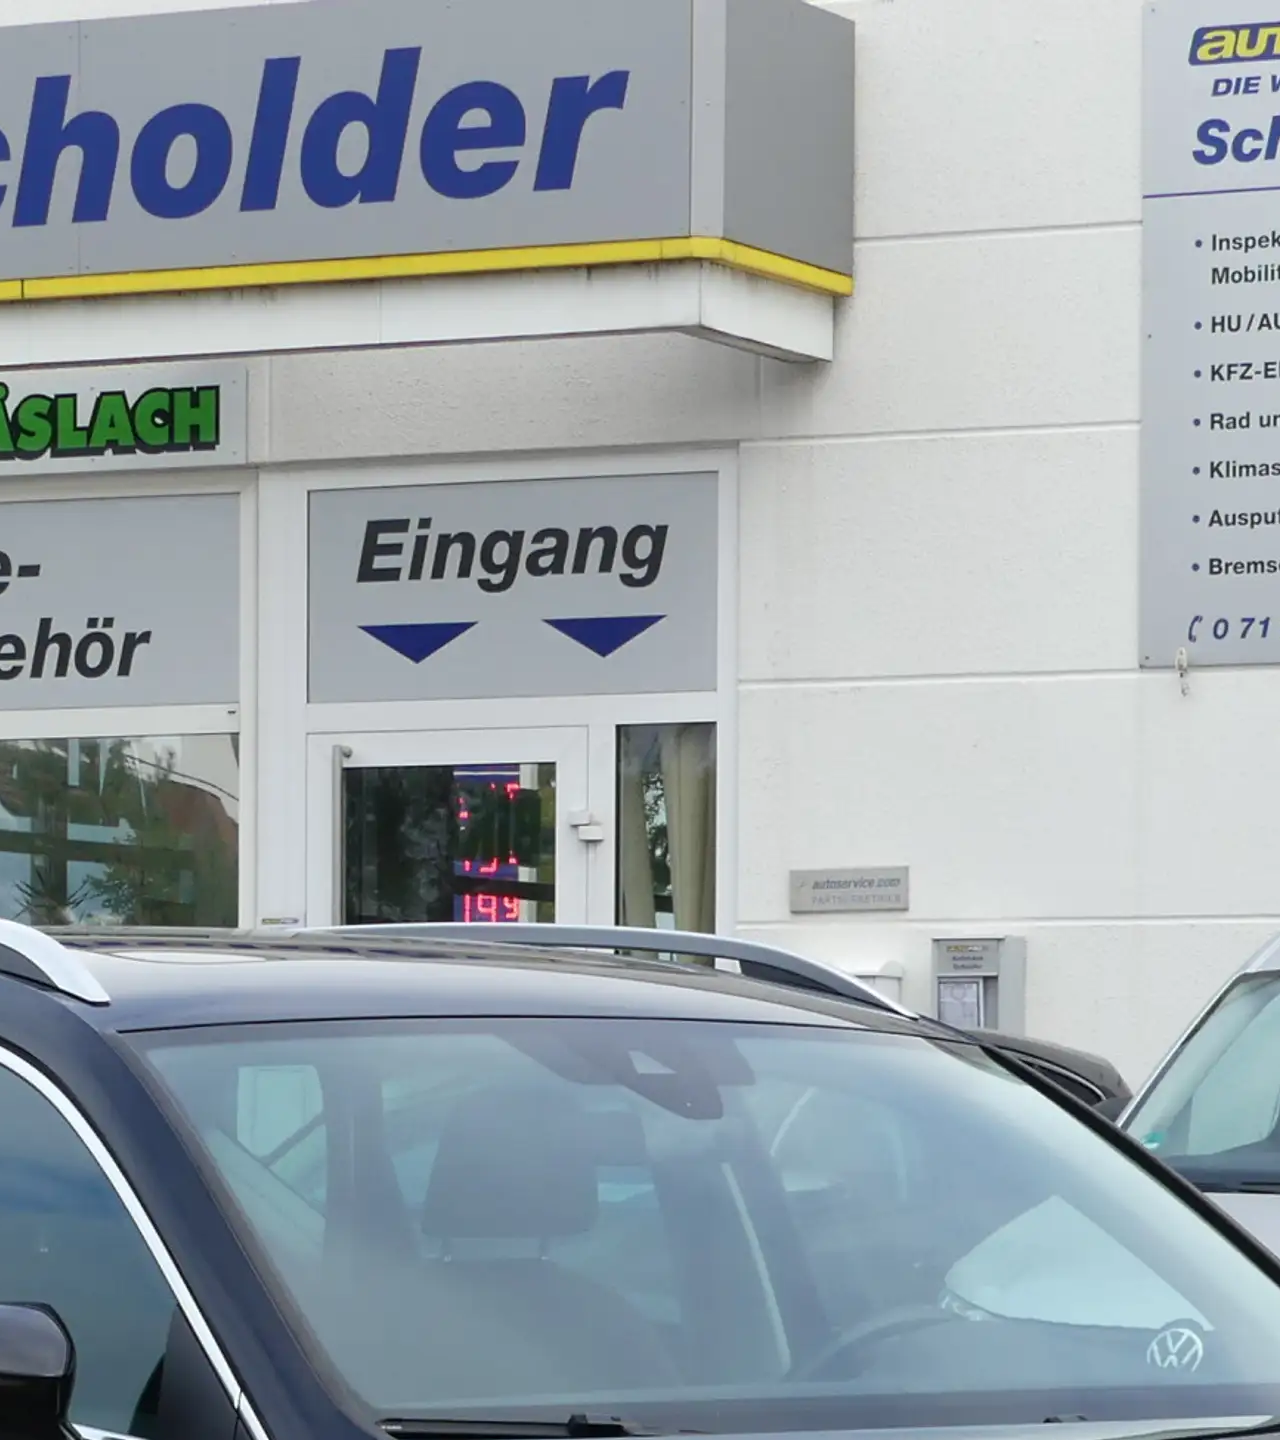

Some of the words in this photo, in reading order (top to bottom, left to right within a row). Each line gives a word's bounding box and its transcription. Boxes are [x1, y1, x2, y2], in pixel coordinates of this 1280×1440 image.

[1211, 75, 1262, 98] DIE
[1209, 410, 1251, 431] Rad
[355, 515, 669, 594] Eingang
